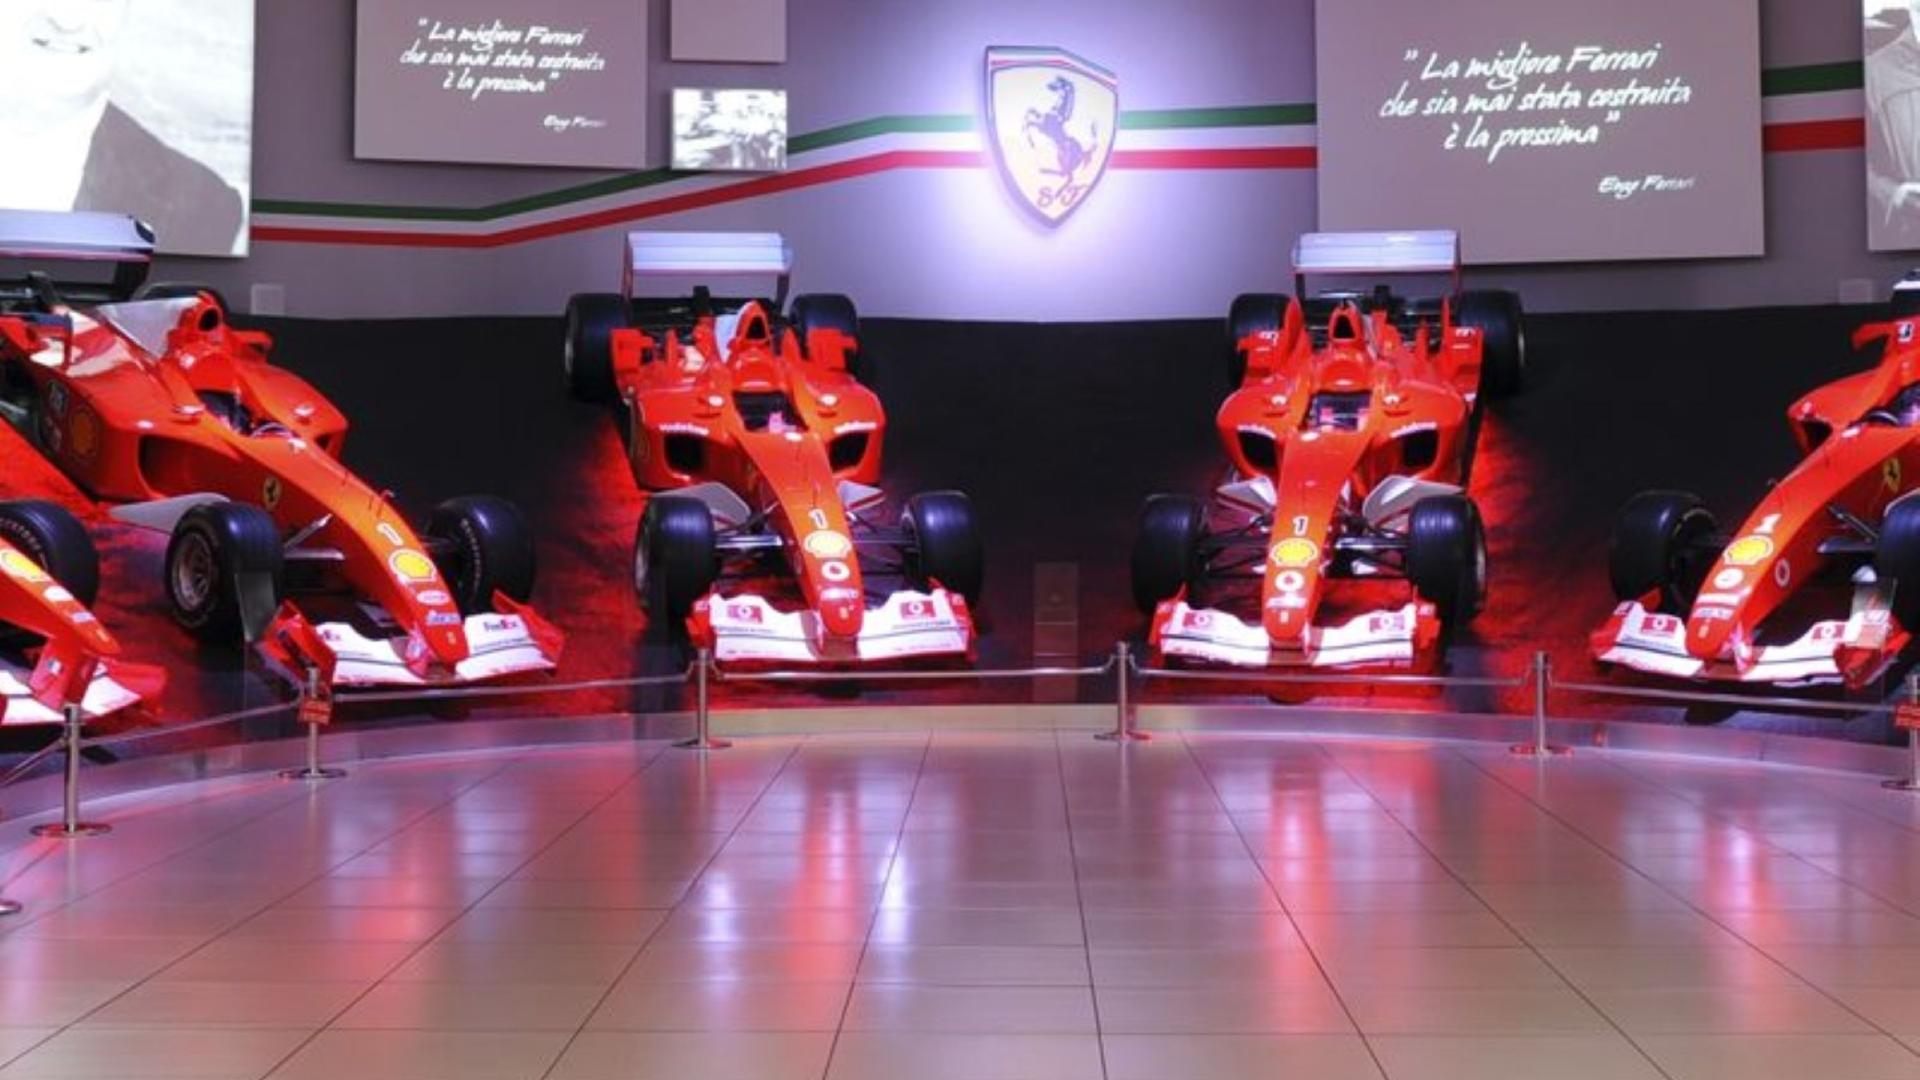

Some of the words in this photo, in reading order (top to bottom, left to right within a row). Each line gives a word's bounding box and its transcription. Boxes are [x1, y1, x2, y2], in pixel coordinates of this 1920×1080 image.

[1464, 42, 1562, 90] migliore
[1566, 42, 1662, 73] Ferrari
[1379, 80, 1419, 117] che
[1422, 88, 1459, 116] sia
[1462, 86, 1516, 114] mai
[1517, 82, 1583, 111] stata
[1588, 76, 1693, 108] costruita
[1464, 115, 1490, 148] la
